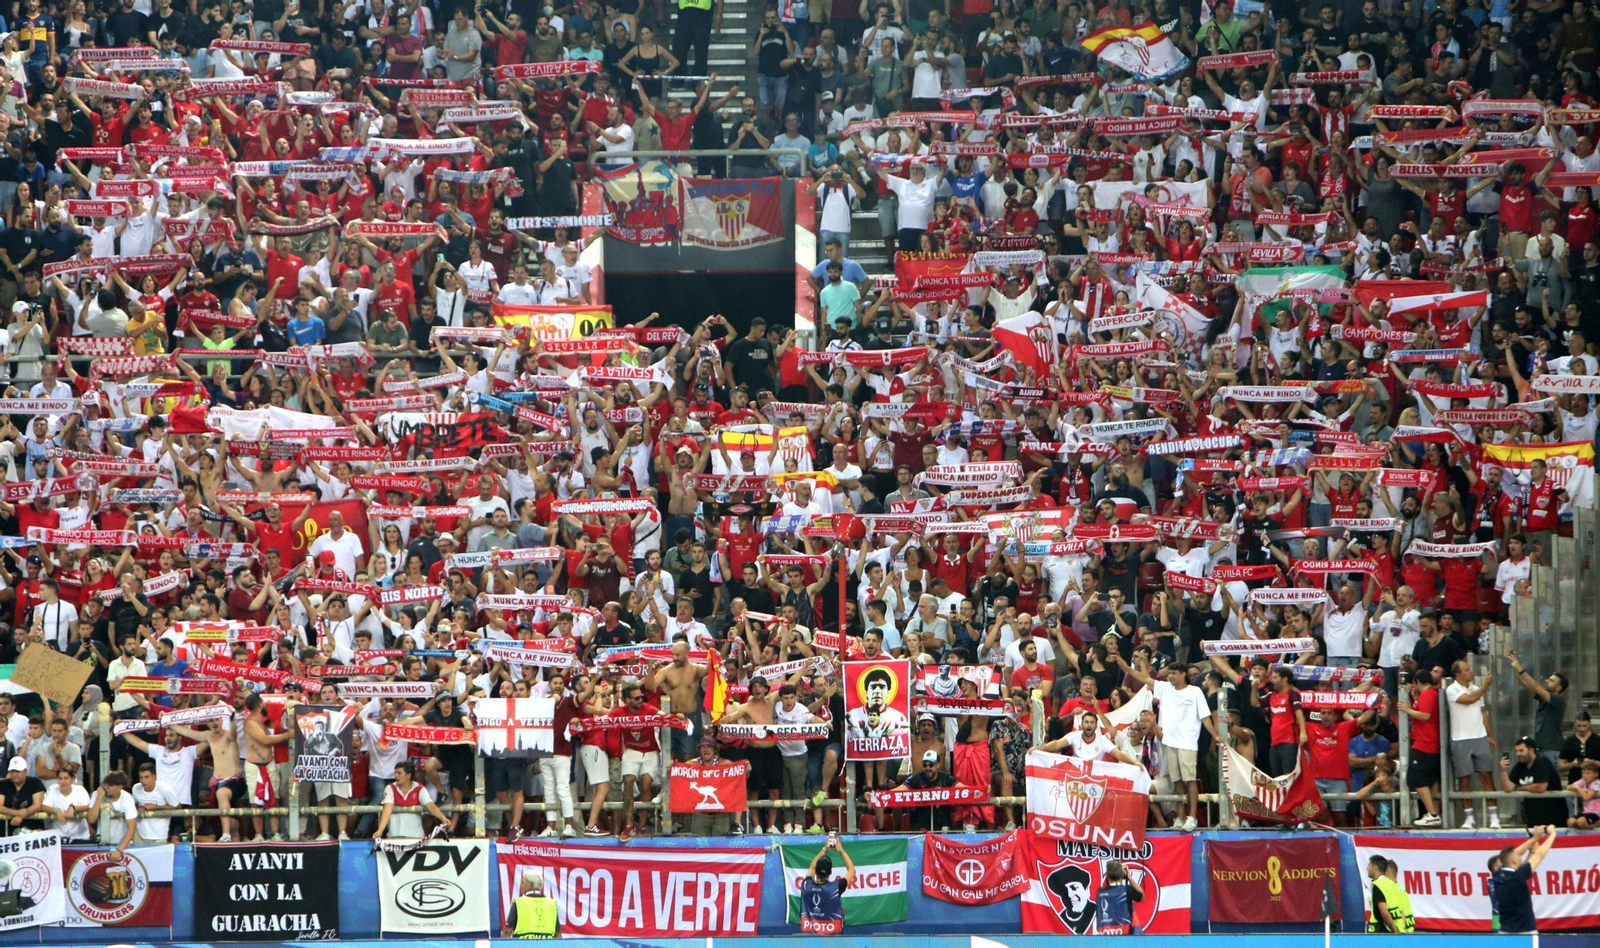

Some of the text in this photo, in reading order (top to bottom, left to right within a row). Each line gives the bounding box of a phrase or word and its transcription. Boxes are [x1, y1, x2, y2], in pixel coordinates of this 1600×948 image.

[1398, 166, 1488, 174] BIRIS NORTE
[1251, 248, 1281, 258] SEVILLA
[922, 275, 988, 285] NUNCA TE RINDAS
[646, 332, 660, 340] DEL
[662, 332, 678, 341] REY
[546, 342, 598, 351] SEVILLA
[0, 402, 68, 410] UNCA ME RINDO
[350, 399, 392, 408] SEVILLA
[391, 418, 498, 446] UMBRETE
[1096, 424, 1123, 434] NUNCA
[1137, 419, 1164, 429] RINDAS
[1148, 436, 1238, 454] BENDITA LOCURA
[351, 450, 381, 458] RINDAS
[86, 462, 127, 472] SEVILLA
[389, 460, 416, 468] NUNCA
[434, 458, 458, 466] RINDO
[1311, 458, 1362, 467] SEVILLA
[354, 478, 378, 486] NUNCA
[391, 479, 417, 488] RINDAS
[702, 478, 748, 486] SEVILLA
[926, 473, 998, 481] NUNCA ME RINDO
[10, 480, 61, 497] SEVILLA
[960, 486, 1028, 499] SUPERCAMPEON
[1156, 521, 1202, 534] SEVILLA
[1054, 542, 1084, 552] SEVILLA
[1416, 544, 1445, 552] NUNCA
[1463, 544, 1487, 552] RINDO
[458, 556, 486, 564] NUNCA
[1214, 568, 1252, 578] SEVILLA FC
[149, 576, 177, 590] RINDO
[306, 578, 372, 592] SEVILLA FC
[493, 597, 522, 605] NUNCA
[525, 598, 536, 606] ME
[1254, 592, 1284, 600] NUNCA
[492, 652, 523, 662] NUNCA
[538, 658, 567, 666] RINDO
[208, 664, 236, 673] NUNCA
[250, 669, 280, 680] RINDAS
[760, 663, 796, 675] NUNCA ME
[938, 700, 992, 710] SEVILLA FC
[594, 715, 660, 725] SEVILLA FC
[385, 728, 435, 740] SEVILLA
[777, 728, 796, 738] SFC
[798, 726, 828, 737] FANS
[852, 736, 904, 751] TERRAZA
[296, 755, 346, 767] AVANTI CON
[294, 768, 348, 780] LA GUARACHA
[670, 765, 744, 777] MORÓN SFC FANS
[894, 790, 970, 802] ETERNO 16
[1032, 818, 1138, 849] OSUNA
[26, 836, 57, 850] FANS
[530, 847, 560, 858] SEVILLISTA
[958, 846, 988, 855] YOUR
[228, 853, 304, 871] AVANTI
[386, 846, 481, 876] VDV
[1212, 867, 1336, 881] NERVION ADDICTS
[1404, 870, 1432, 894] MI
[1436, 868, 1472, 896] TÍO
[1546, 864, 1600, 896] RAZÓ
[229, 884, 303, 902] CON LA
[499, 863, 760, 932] VNGO A VERTE
[78, 903, 134, 920] DRUNKERS
[212, 914, 321, 932] GUARACHA
[804, 921, 835, 932] PHOTO
